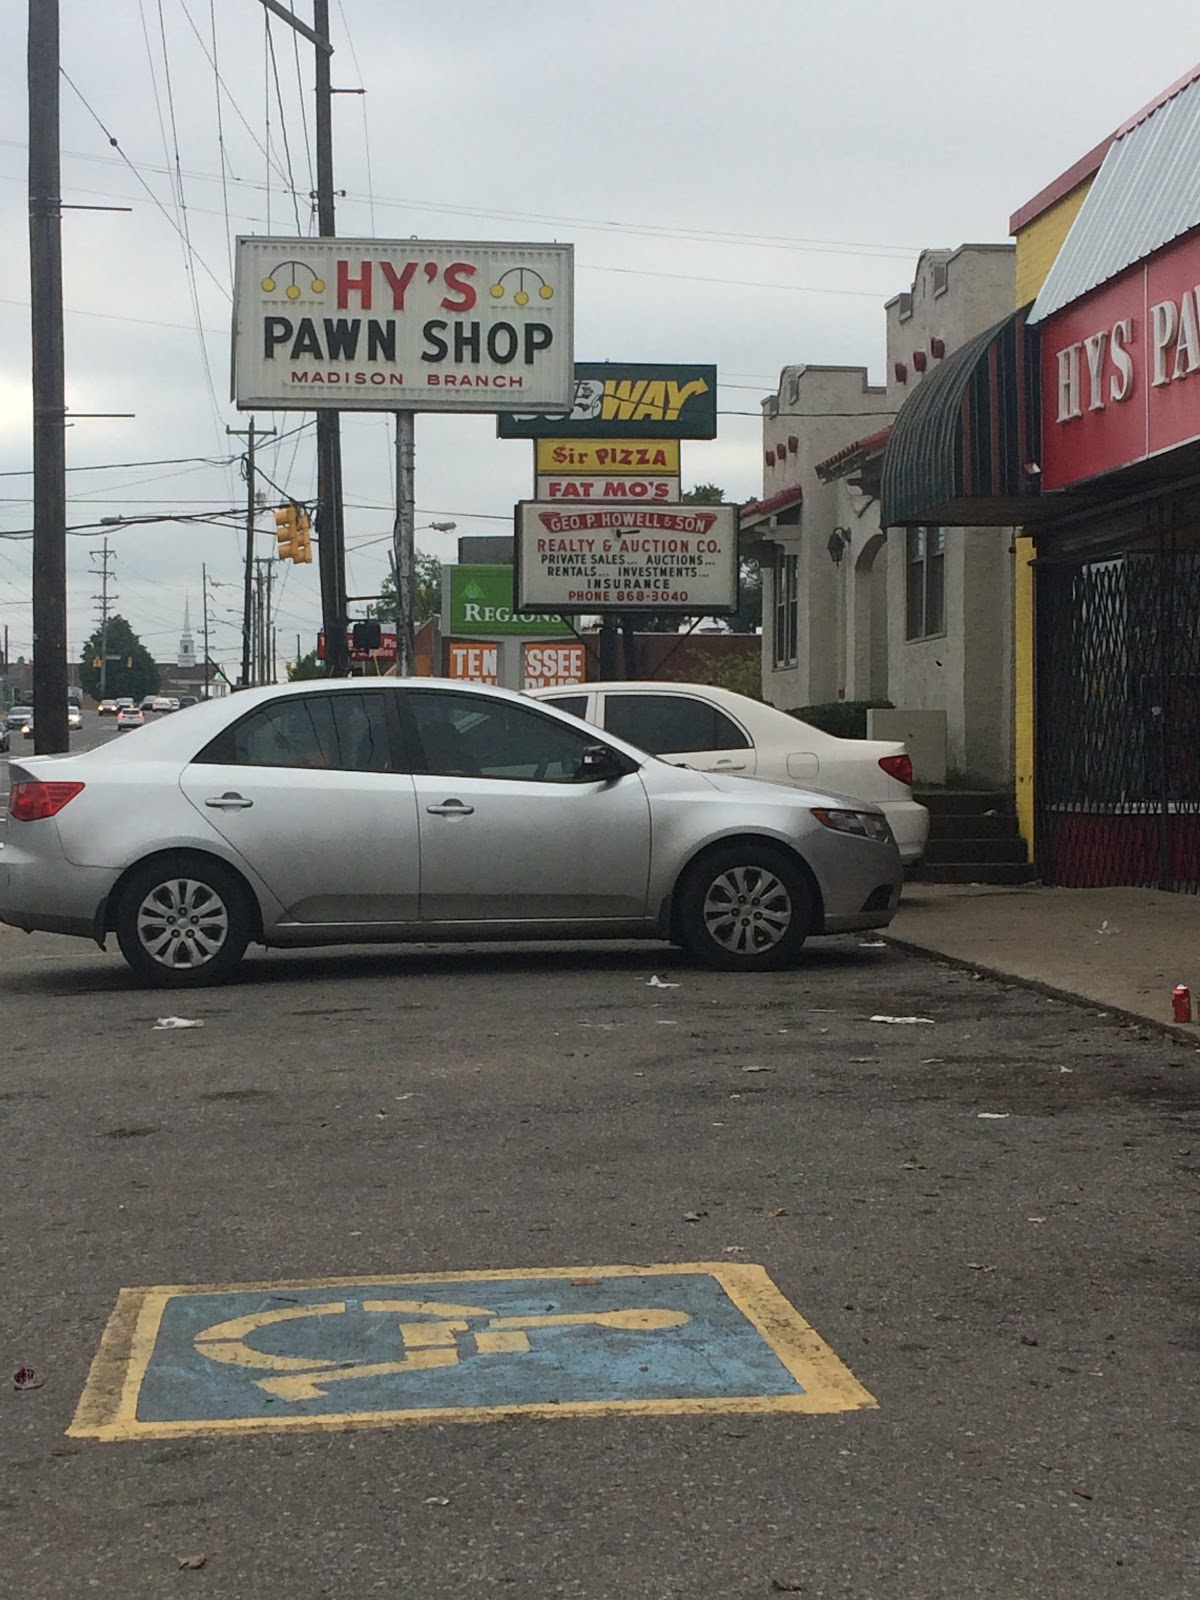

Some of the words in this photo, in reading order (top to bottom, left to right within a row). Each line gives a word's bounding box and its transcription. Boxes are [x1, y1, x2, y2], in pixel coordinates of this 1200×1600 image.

[336, 260, 477, 312] HY'S
[264, 316, 397, 361] PAWN
[421, 320, 553, 364] SHOP
[1056, 318, 1134, 423] HYS
[1150, 284, 1200, 386] PA
[291, 371, 403, 385] MADISON
[427, 374, 523, 388] BRANCH
[512, 377, 709, 423] BWAY
[552, 444, 589, 465] Sir
[595, 449, 667, 466] PIZZA
[549, 482, 594, 497] FAT
[603, 481, 669, 498] MO'S
[550, 515, 584, 532] GEO.
[601, 512, 660, 528] HOWELL
[663, 516, 672, 527] &
[675, 516, 705, 533] SON
[537, 539, 595, 552] REALTY
[602, 538, 612, 552] &
[619, 539, 689, 553] AUCTION
[697, 540, 721, 553] CO.
[541, 554, 587, 565] PRIVATE
[587, 579, 670, 589] INSURANCE
[568, 591, 610, 602] PHONE
[616, 591, 688, 602] 868-3040
